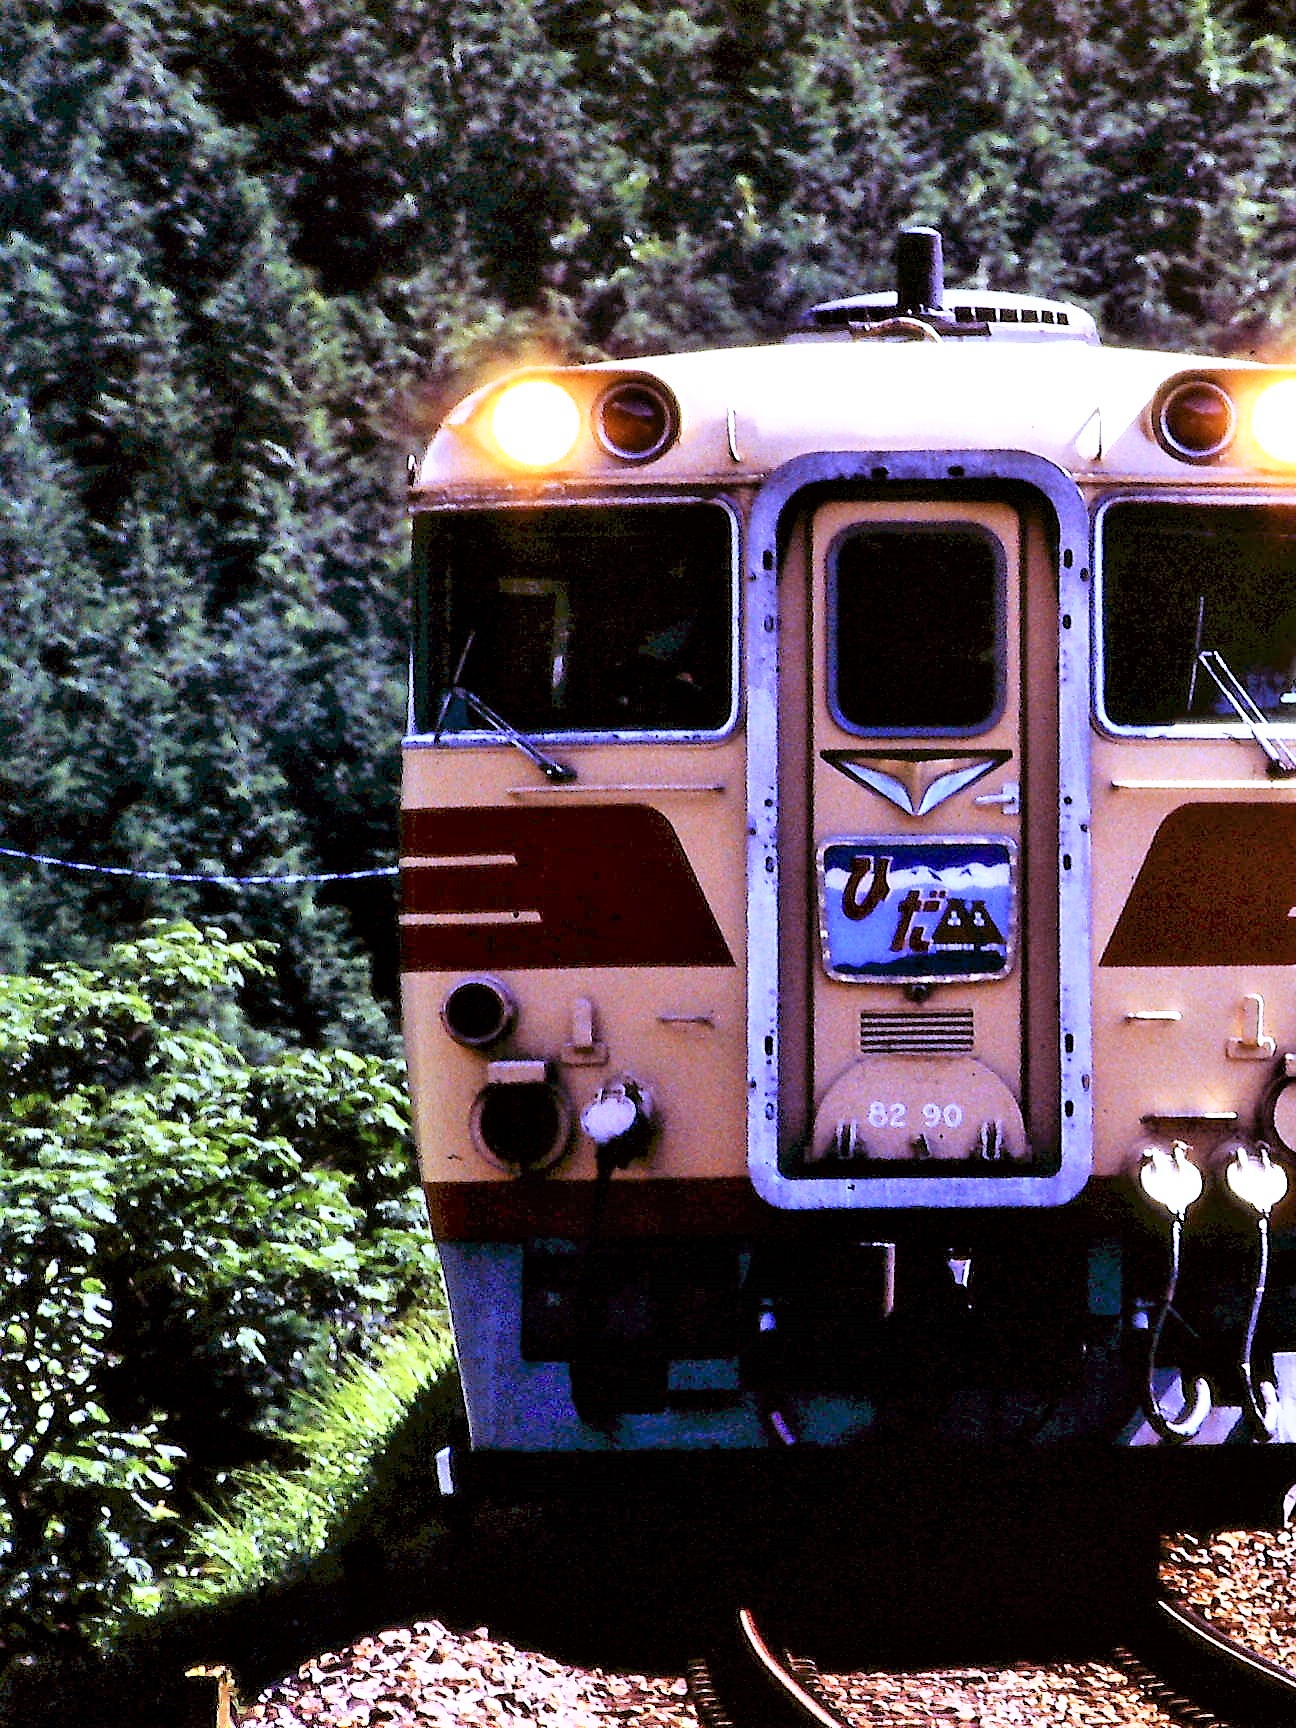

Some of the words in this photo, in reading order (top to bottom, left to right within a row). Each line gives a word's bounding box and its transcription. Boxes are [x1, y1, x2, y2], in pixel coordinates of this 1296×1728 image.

[842, 856, 948, 952] ひだ
[868, 1101, 907, 1128] 82
[922, 1103, 963, 1128] 90
